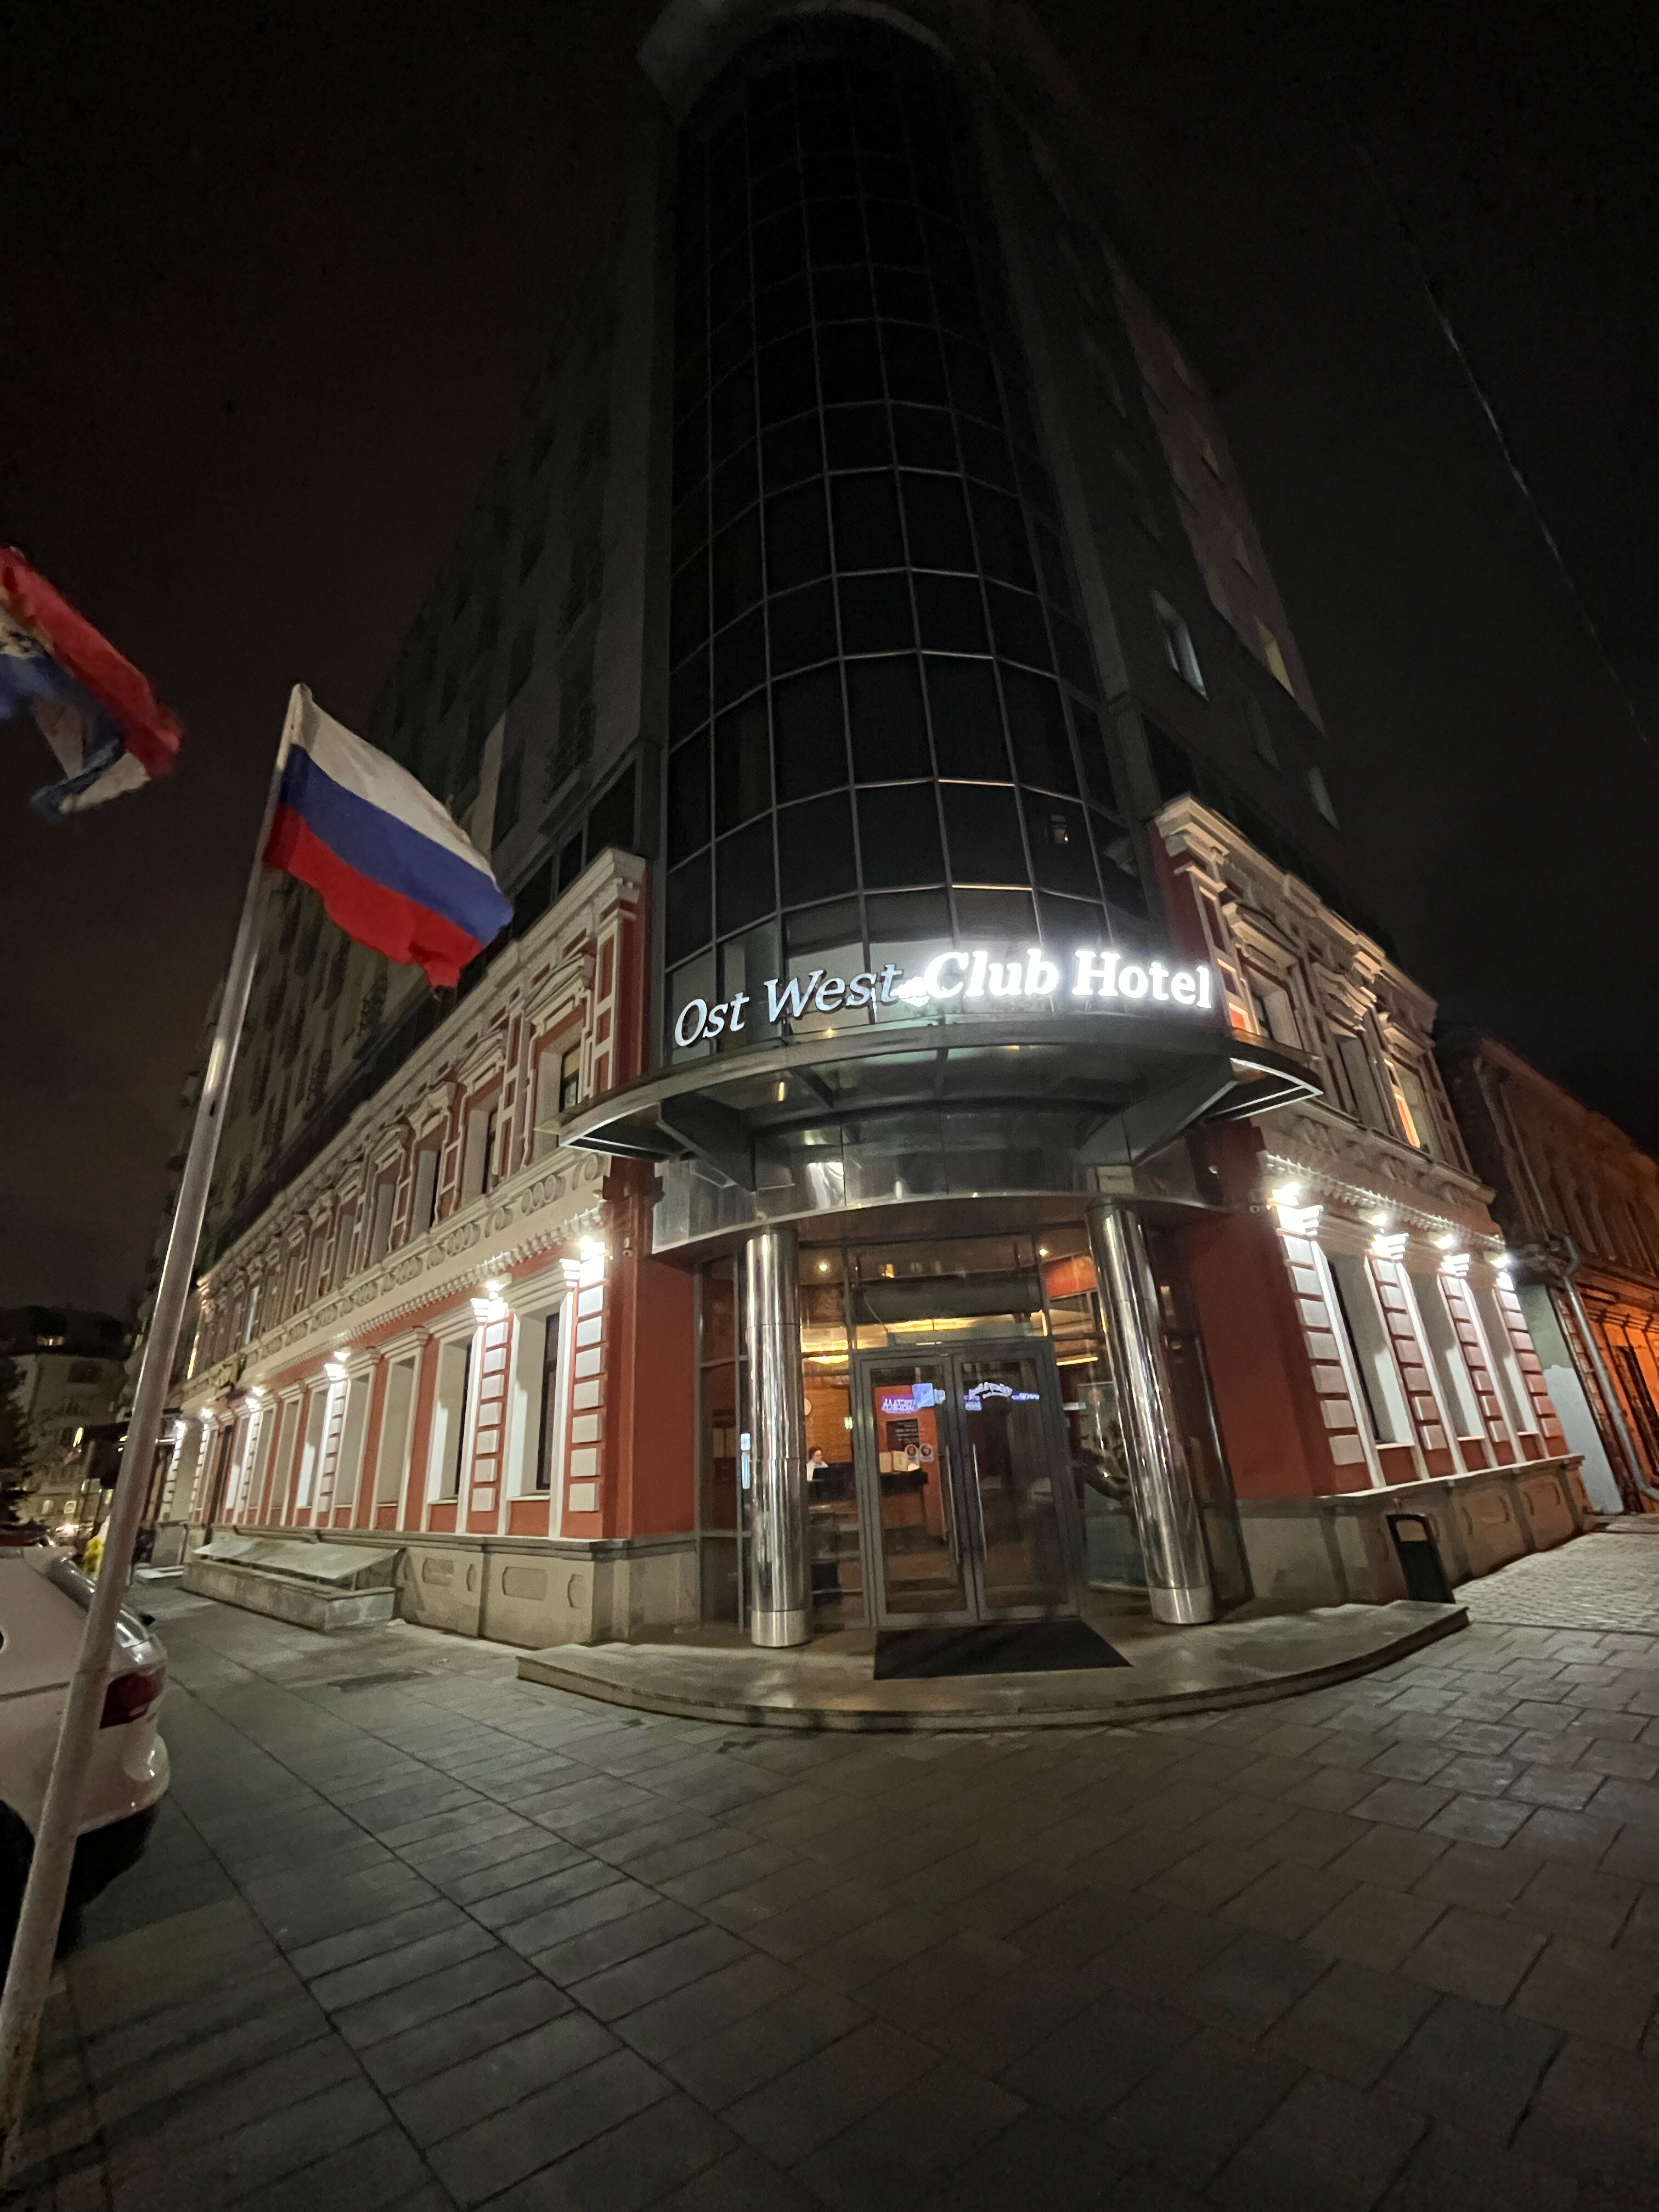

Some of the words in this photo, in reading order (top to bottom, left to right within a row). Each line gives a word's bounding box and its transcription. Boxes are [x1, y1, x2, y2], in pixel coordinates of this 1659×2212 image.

[674, 992, 749, 1046] Ost
[764, 963, 902, 1023] West
[923, 948, 1059, 998] Club
[1071, 949, 1211, 1008] Hotel
